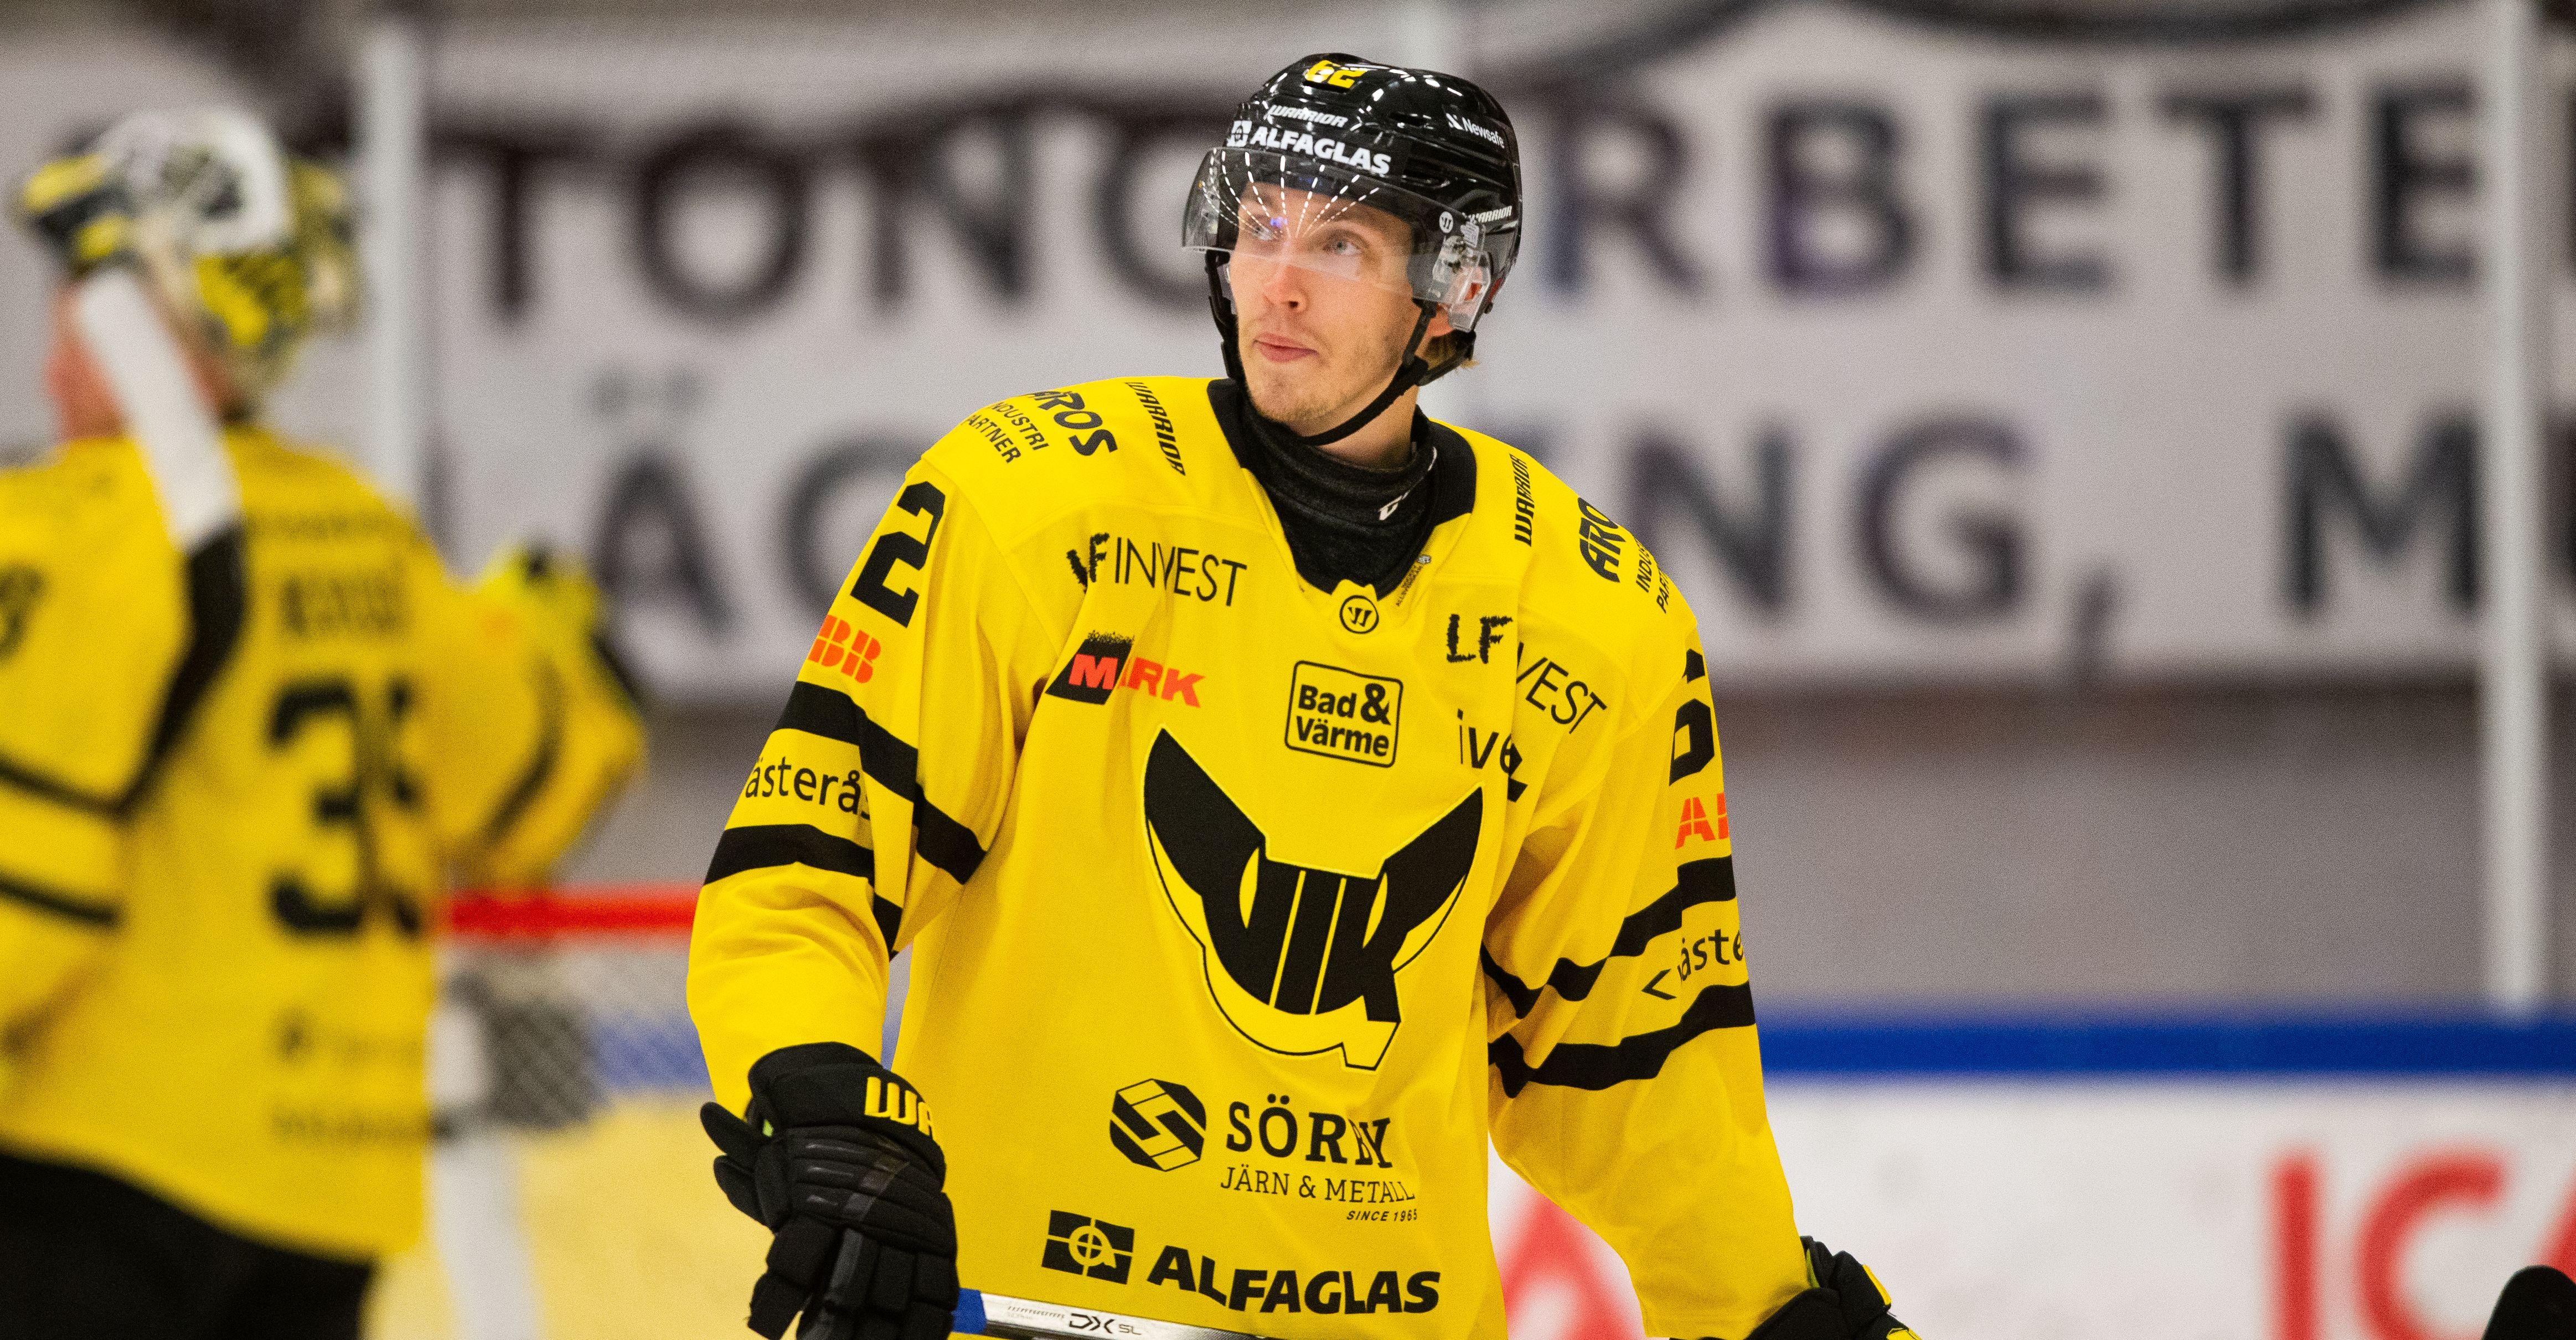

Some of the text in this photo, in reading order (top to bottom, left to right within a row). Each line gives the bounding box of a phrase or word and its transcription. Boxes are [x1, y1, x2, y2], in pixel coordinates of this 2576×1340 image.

[1304, 60, 1369, 89] 62
[1264, 105, 1349, 128] WARRIOR
[1462, 116, 1505, 149] Newsafe
[1249, 126, 1392, 177] ALFAGLAS
[964, 414, 1021, 464] ARTNER
[1124, 382, 1186, 475] WARRIOR
[1509, 454, 1535, 547] WARRIOR
[1114, 537, 1247, 607] INVEST
[807, 614, 881, 684] BB
[1446, 613, 1607, 734] LF VEST
[1295, 715, 1390, 757] Värme
[745, 755, 871, 821] ästerå
[1220, 1164, 1416, 1203] JÄRN & METALL
[1346, 1210, 1390, 1222] SINCE
[1147, 1245, 1441, 1315] ALFAGLAS
